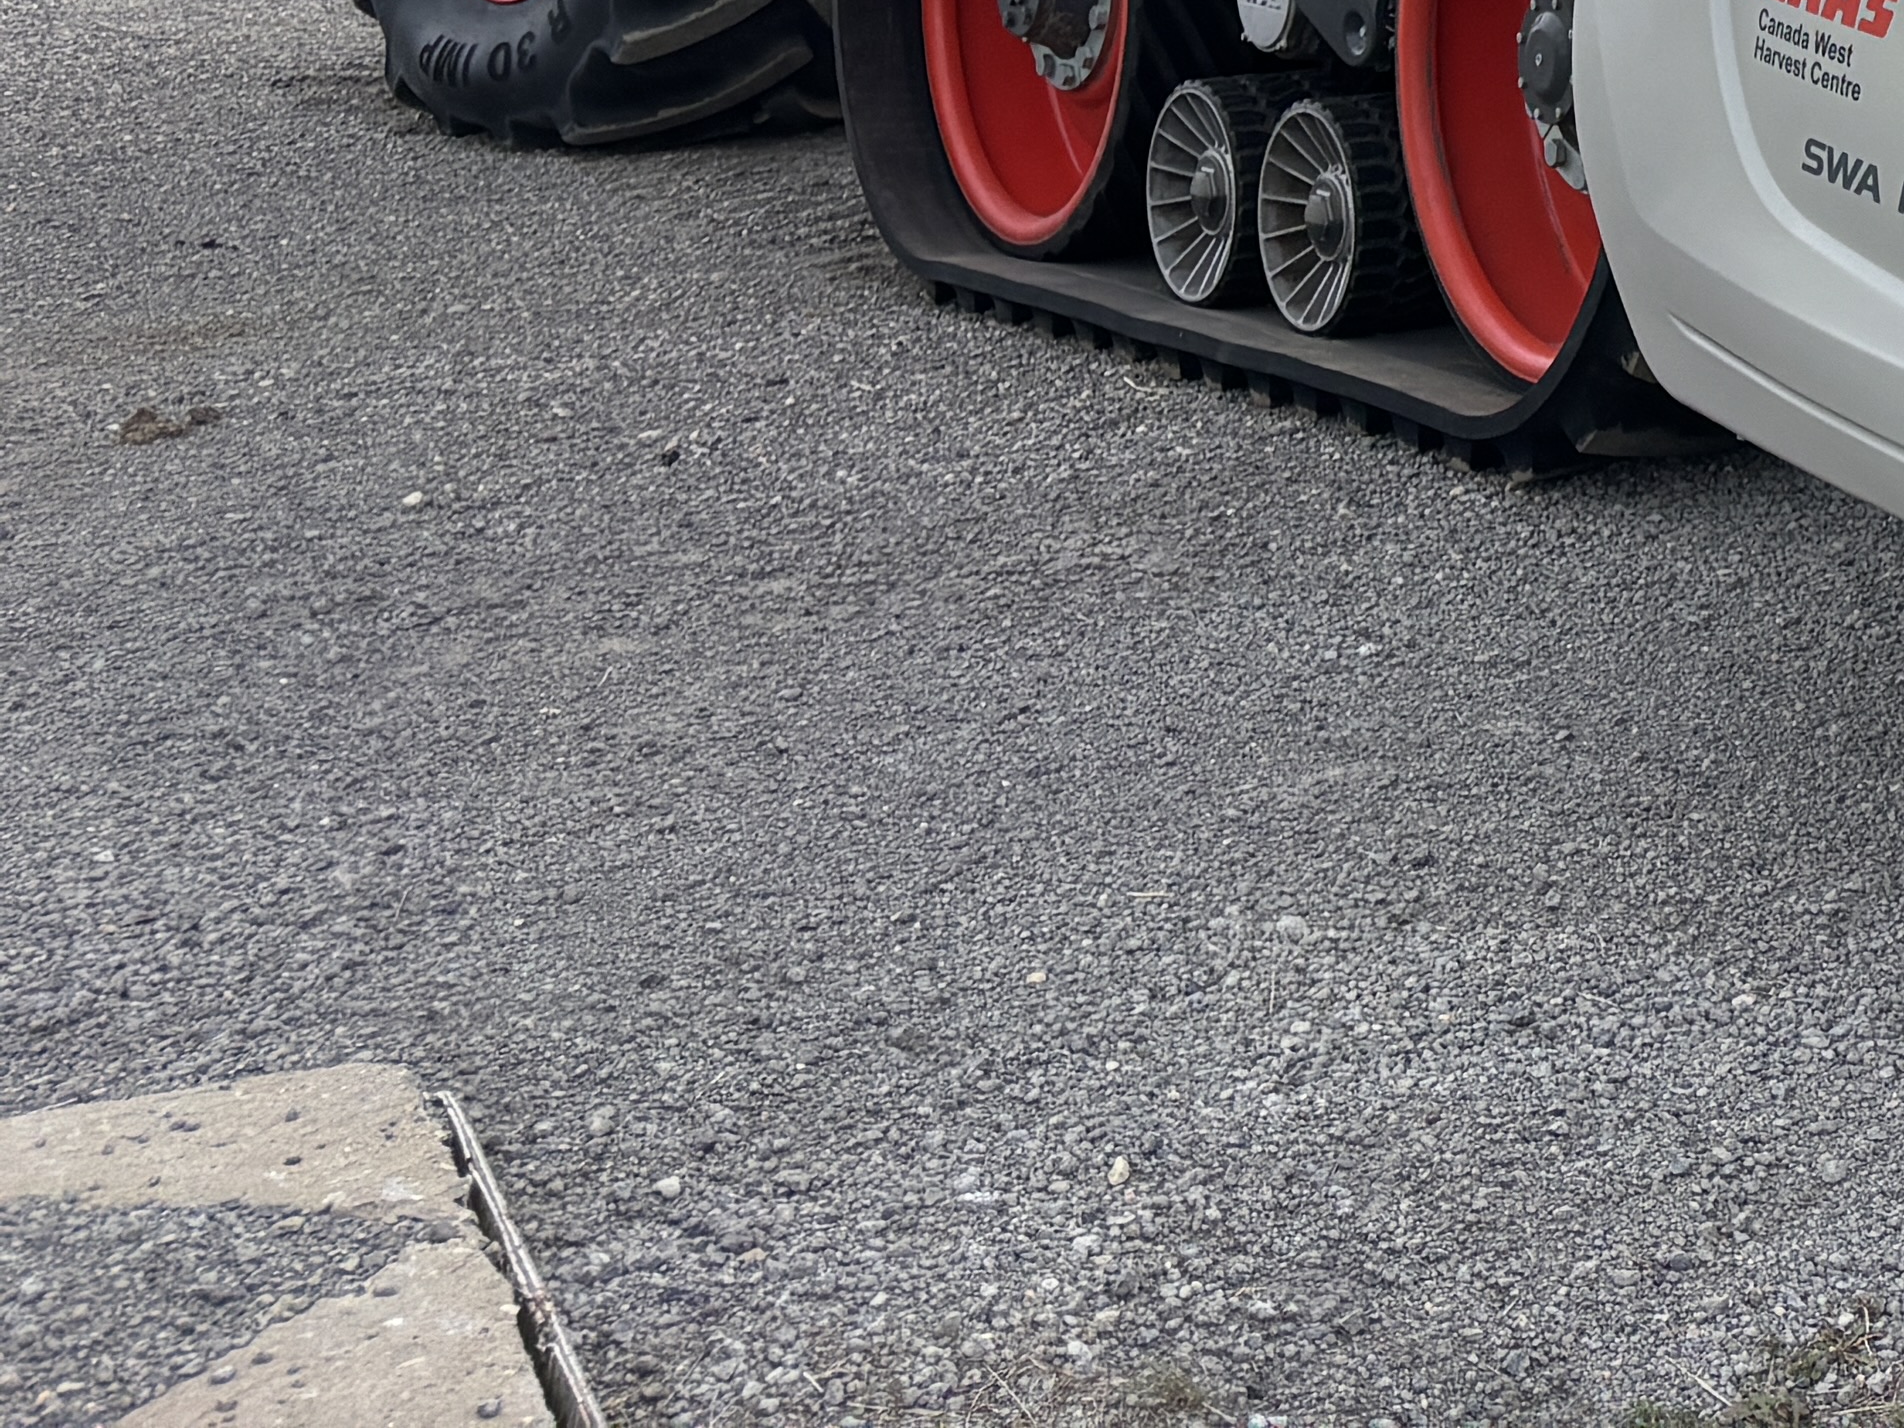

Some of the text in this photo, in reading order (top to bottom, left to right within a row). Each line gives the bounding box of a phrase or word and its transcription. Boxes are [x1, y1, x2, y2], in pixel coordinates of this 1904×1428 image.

[1754, 35, 1861, 101] Harvest Centre
[1758, 8, 1854, 68] Canada West
